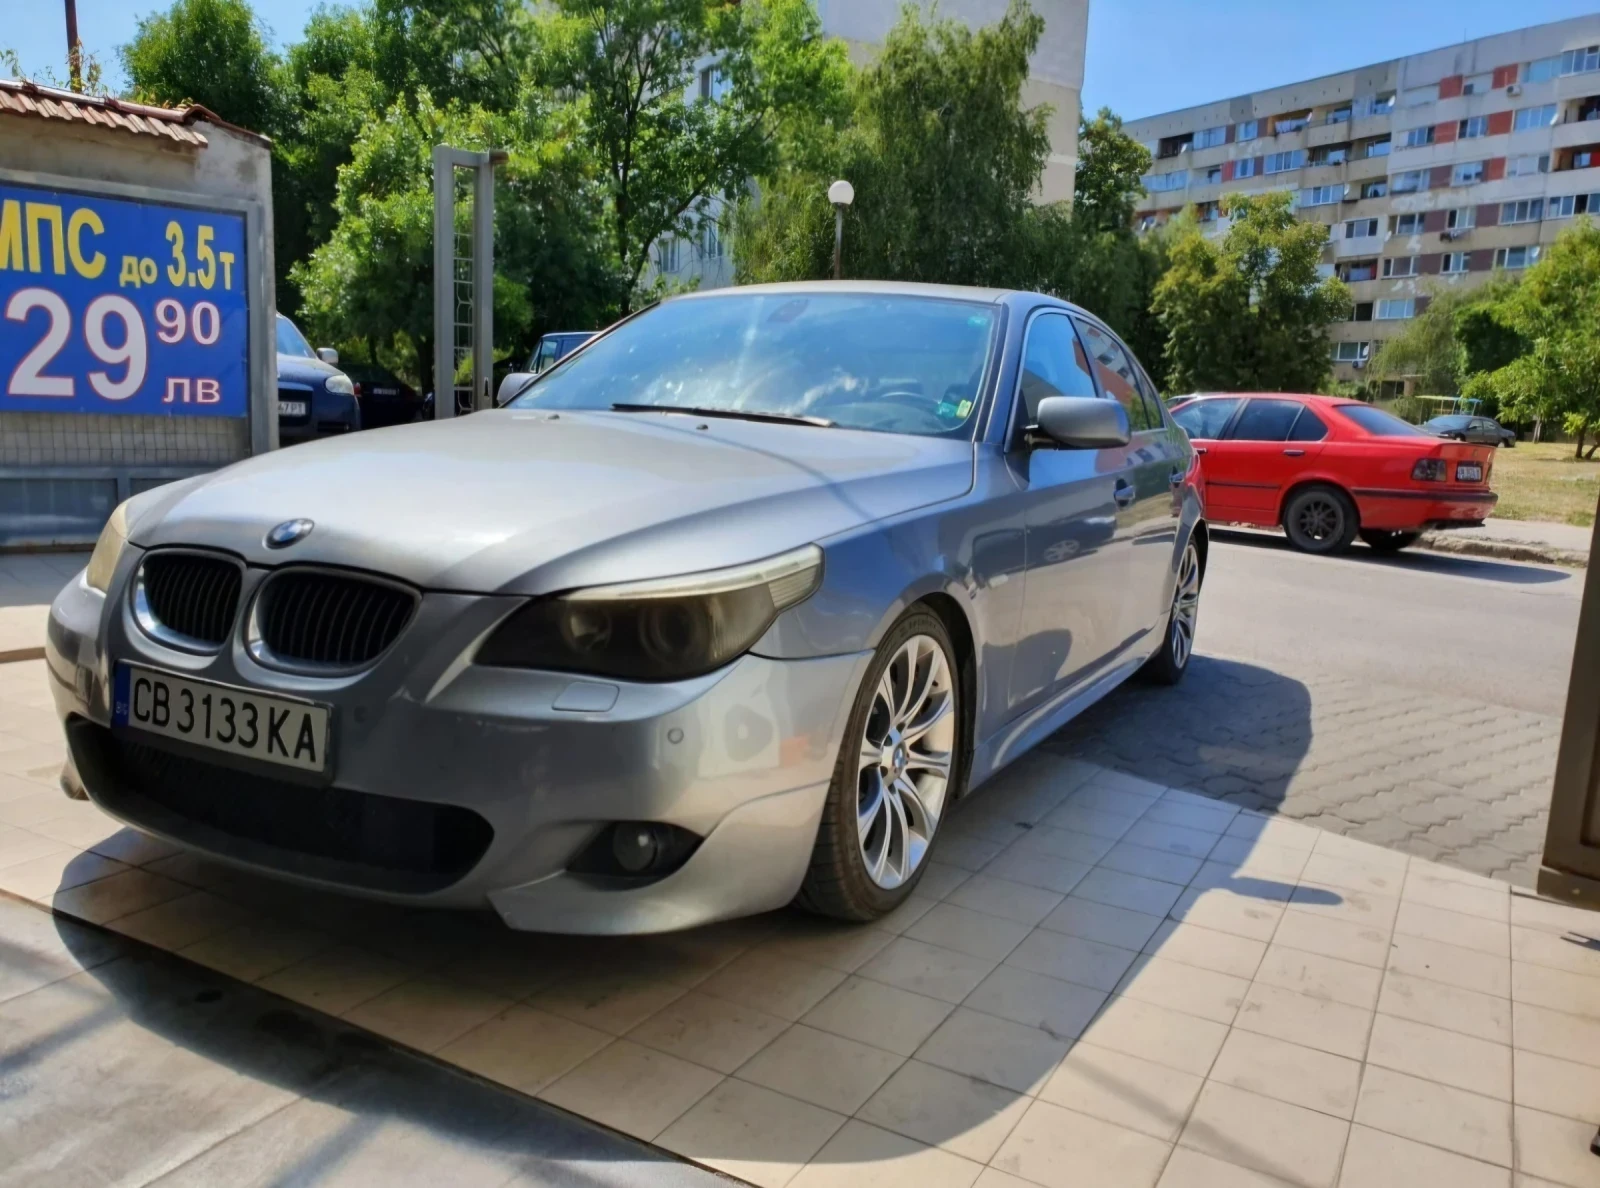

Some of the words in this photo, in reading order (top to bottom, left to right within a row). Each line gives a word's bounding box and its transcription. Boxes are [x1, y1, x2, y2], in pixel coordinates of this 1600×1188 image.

[119, 256, 158, 288] до
[5, 287, 149, 400] 29
[155, 298, 221, 345] 90
